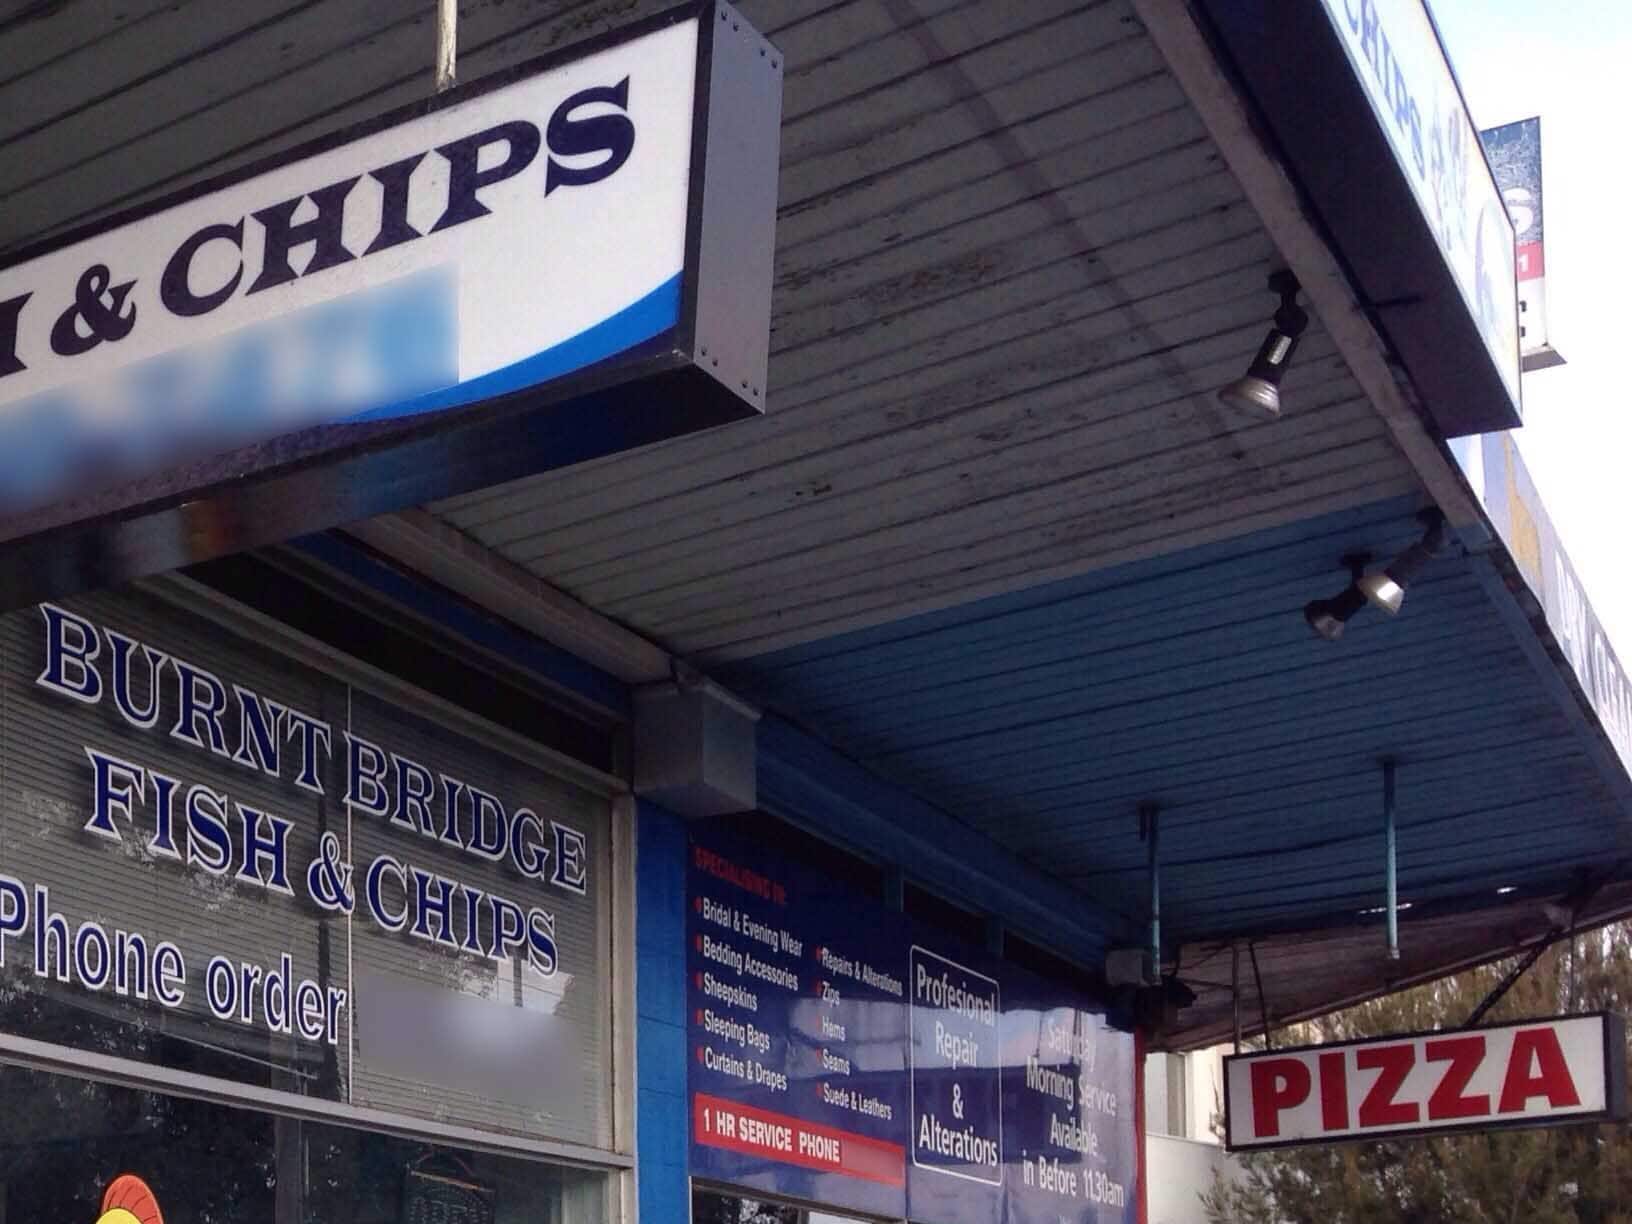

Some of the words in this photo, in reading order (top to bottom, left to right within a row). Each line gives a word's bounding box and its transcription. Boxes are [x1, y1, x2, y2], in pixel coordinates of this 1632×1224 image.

[50, 264, 137, 359] &
[160, 75, 636, 312] CHIPS
[37, 602, 332, 795] BURNT
[343, 730, 587, 895] BRIDGE
[84, 746, 294, 896] FISH
[307, 831, 354, 913] &
[367, 856, 558, 980] CHIPS
[703, 897, 732, 928] Bridal
[733, 910, 740, 932] &
[743, 913, 779, 953] Evening
[780, 929, 803, 958] Wear
[703, 935, 743, 976] Bedding
[744, 952, 799, 990] Accessories
[822, 947, 854, 979] Repairs
[862, 963, 903, 997] Alterations
[207, 952, 347, 1043] order
[704, 971, 758, 1012] Sheepskins
[822, 981, 840, 1008] Zips
[917, 963, 995, 1027] Profesional
[704, 1009, 745, 1048] Sleeping
[747, 1024, 770, 1053] Bags
[822, 1015, 846, 1042] Hems
[935, 1020, 979, 1070] Repair
[705, 1047, 745, 1080] Curtains
[746, 1060, 754, 1081] &
[756, 1062, 788, 1093] Drapes
[822, 1048, 850, 1076] Seams
[1026, 1055, 1074, 1110] Morning
[1078, 1076, 1117, 1117] Service
[1249, 1026, 1581, 1138] PIZZA
[823, 1082, 850, 1108] Suede
[858, 1093, 892, 1120] Leathers
[952, 1083, 964, 1119] &
[703, 1108, 711, 1132] 1
[716, 1111, 736, 1138] HR
[739, 1116, 792, 1152] SERVICE
[799, 1131, 841, 1162] PHONE
[919, 1114, 998, 1167] Alterations
[1050, 1113, 1099, 1157] Available
[1023, 1149, 1034, 1186] in
[1039, 1156, 1077, 1197] Before
